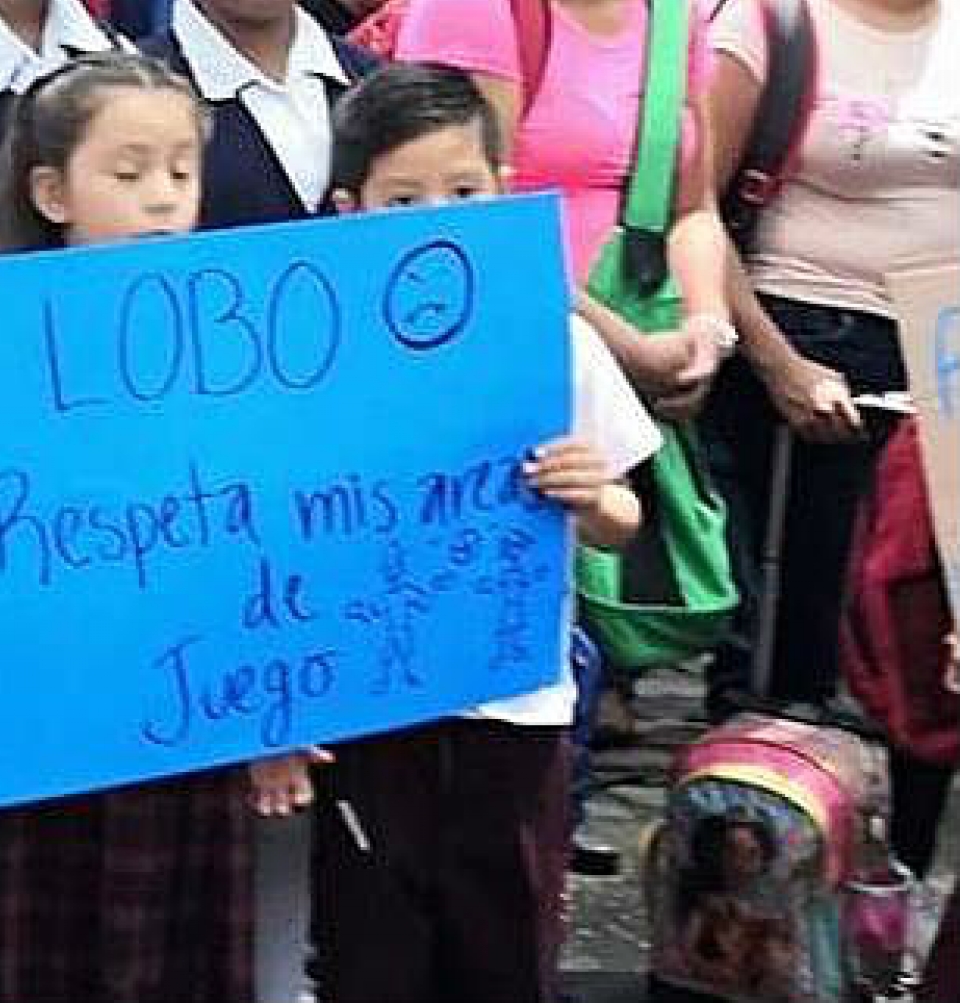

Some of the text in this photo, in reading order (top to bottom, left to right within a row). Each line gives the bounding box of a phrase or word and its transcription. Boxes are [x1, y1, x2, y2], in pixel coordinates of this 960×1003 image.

[41, 260, 340, 412] LOBO
[294, 476, 397, 541] mis
[243, 558, 319, 630] de
[142, 636, 338, 747] Juego
